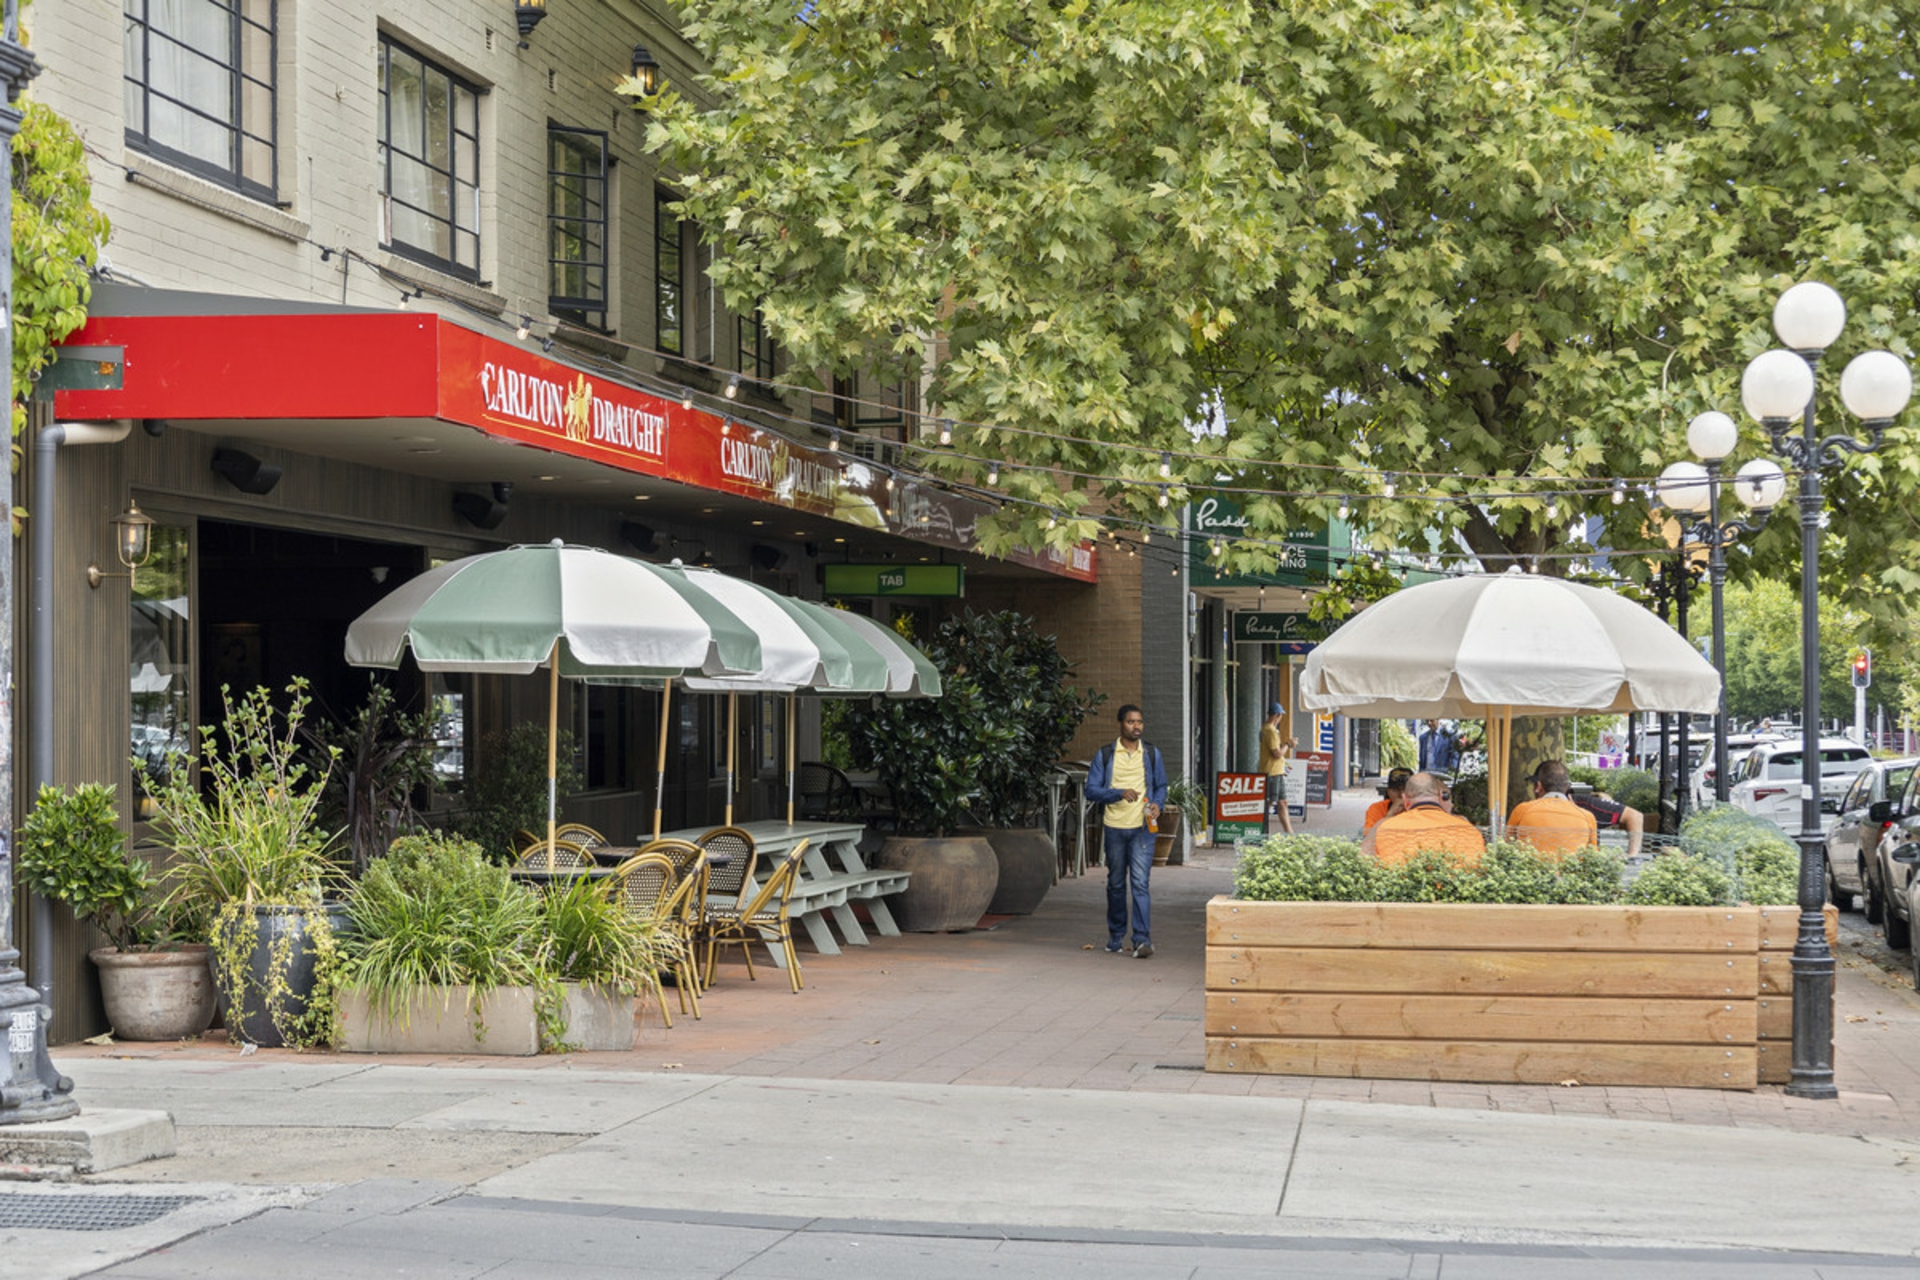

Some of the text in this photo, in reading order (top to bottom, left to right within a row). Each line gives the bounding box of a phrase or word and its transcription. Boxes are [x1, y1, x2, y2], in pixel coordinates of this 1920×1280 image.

[480, 361, 665, 456] CARLTON DRAUGHT
[720, 436, 772, 484] CARLTON
[880, 574, 904, 586] TAB
[1246, 615, 1280, 639] Paddy
[1218, 777, 1266, 795] SALE
